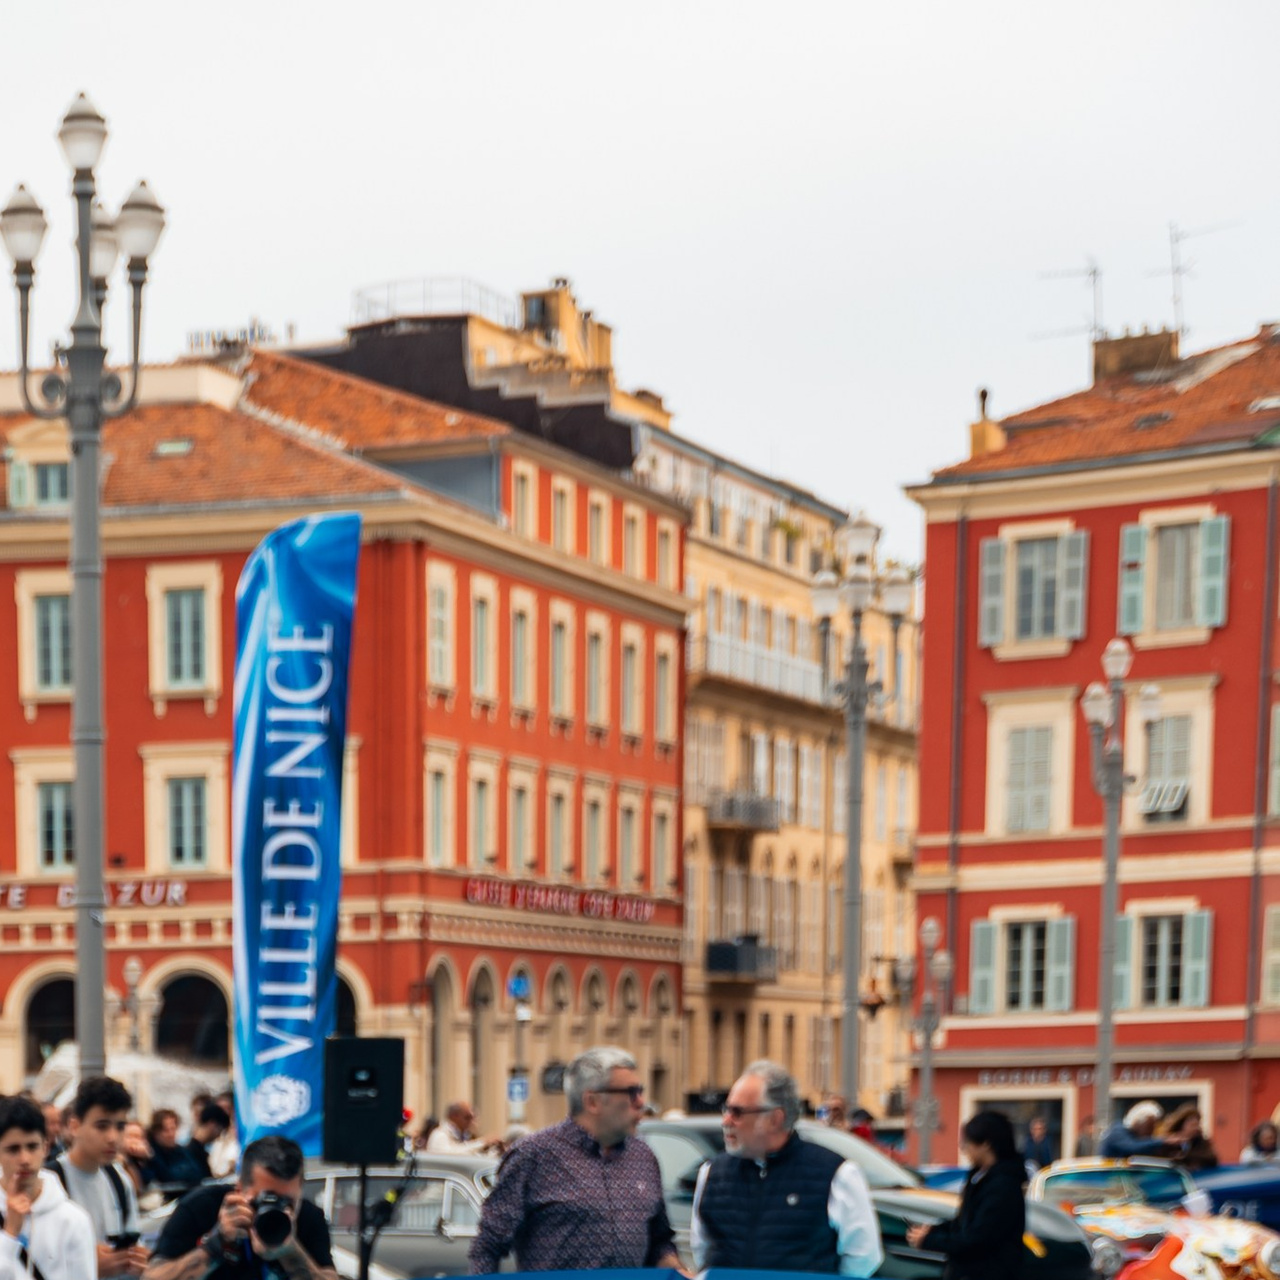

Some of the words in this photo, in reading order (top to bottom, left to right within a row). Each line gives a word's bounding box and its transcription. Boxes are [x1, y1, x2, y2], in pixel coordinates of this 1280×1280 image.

[264, 622, 334, 780] NICE
[261, 796, 321, 882] DE
[56, 879, 187, 910] DZUR
[255, 900, 319, 1066] VILLE
[1076, 1064, 1195, 1087] DAUNAY
